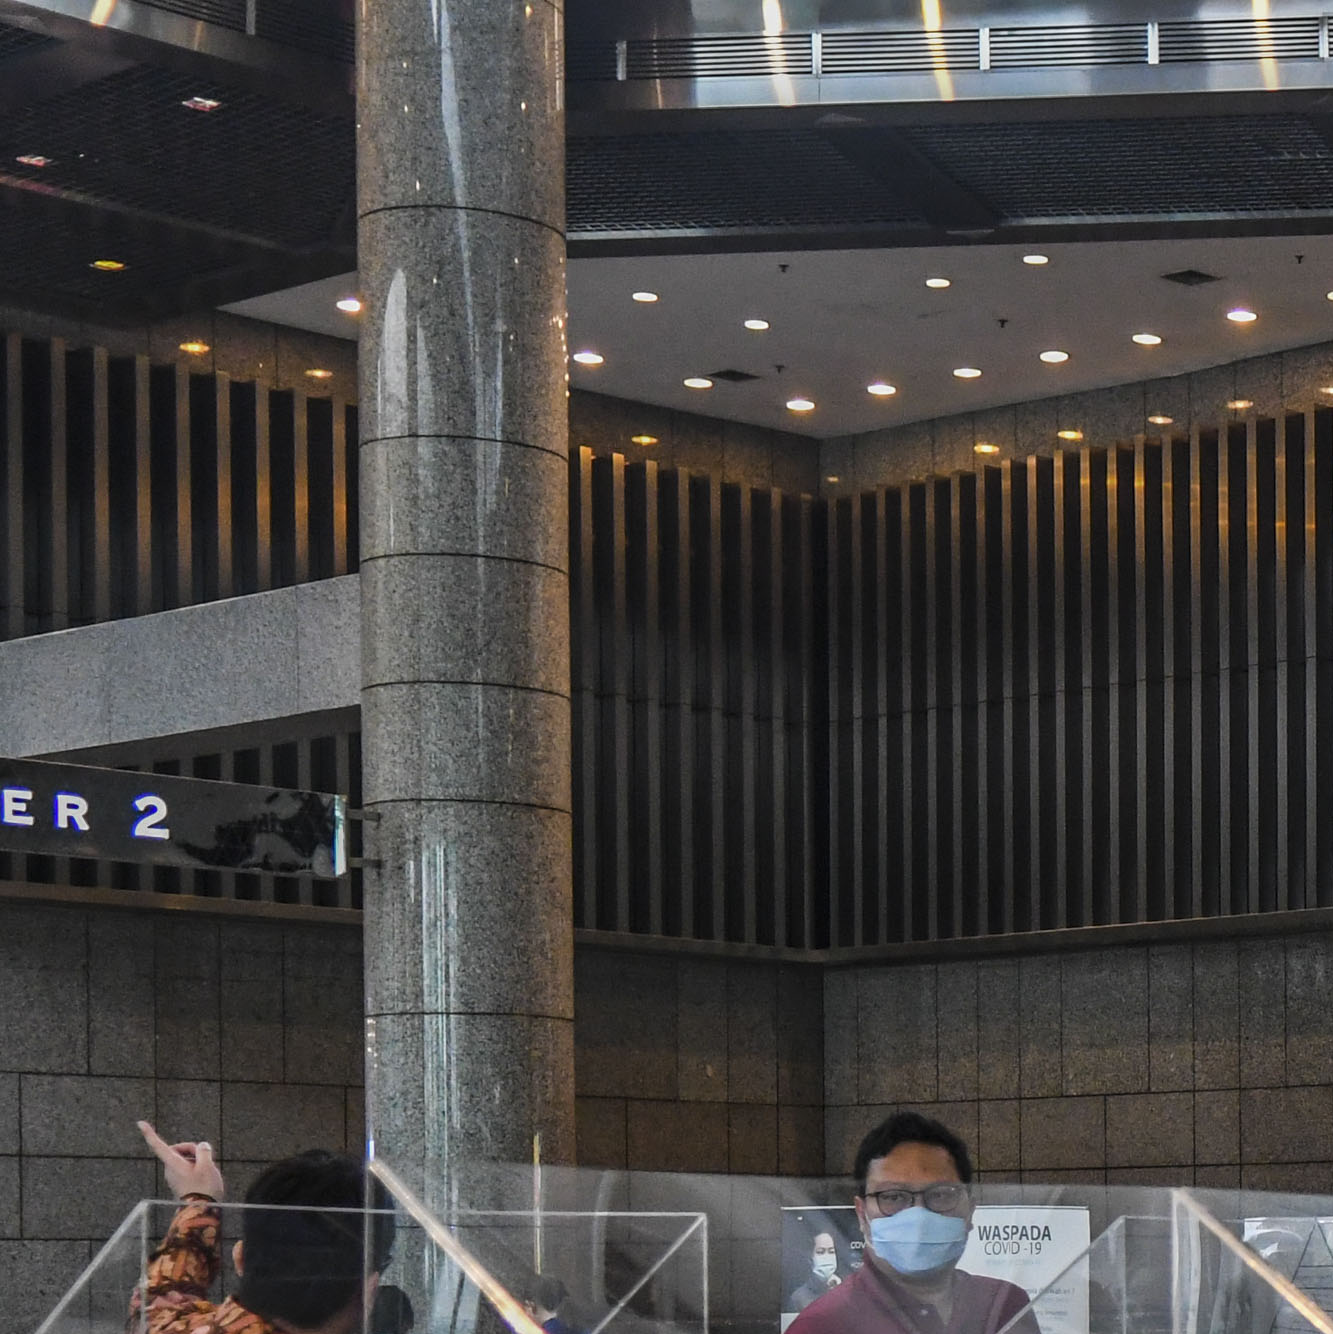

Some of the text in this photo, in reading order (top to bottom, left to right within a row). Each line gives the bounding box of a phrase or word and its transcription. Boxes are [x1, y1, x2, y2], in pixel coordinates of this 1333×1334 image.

[132, 795, 170, 840] 2
[978, 1225, 1052, 1241] WASPADA
[984, 1241, 1042, 1255] COVID -19
